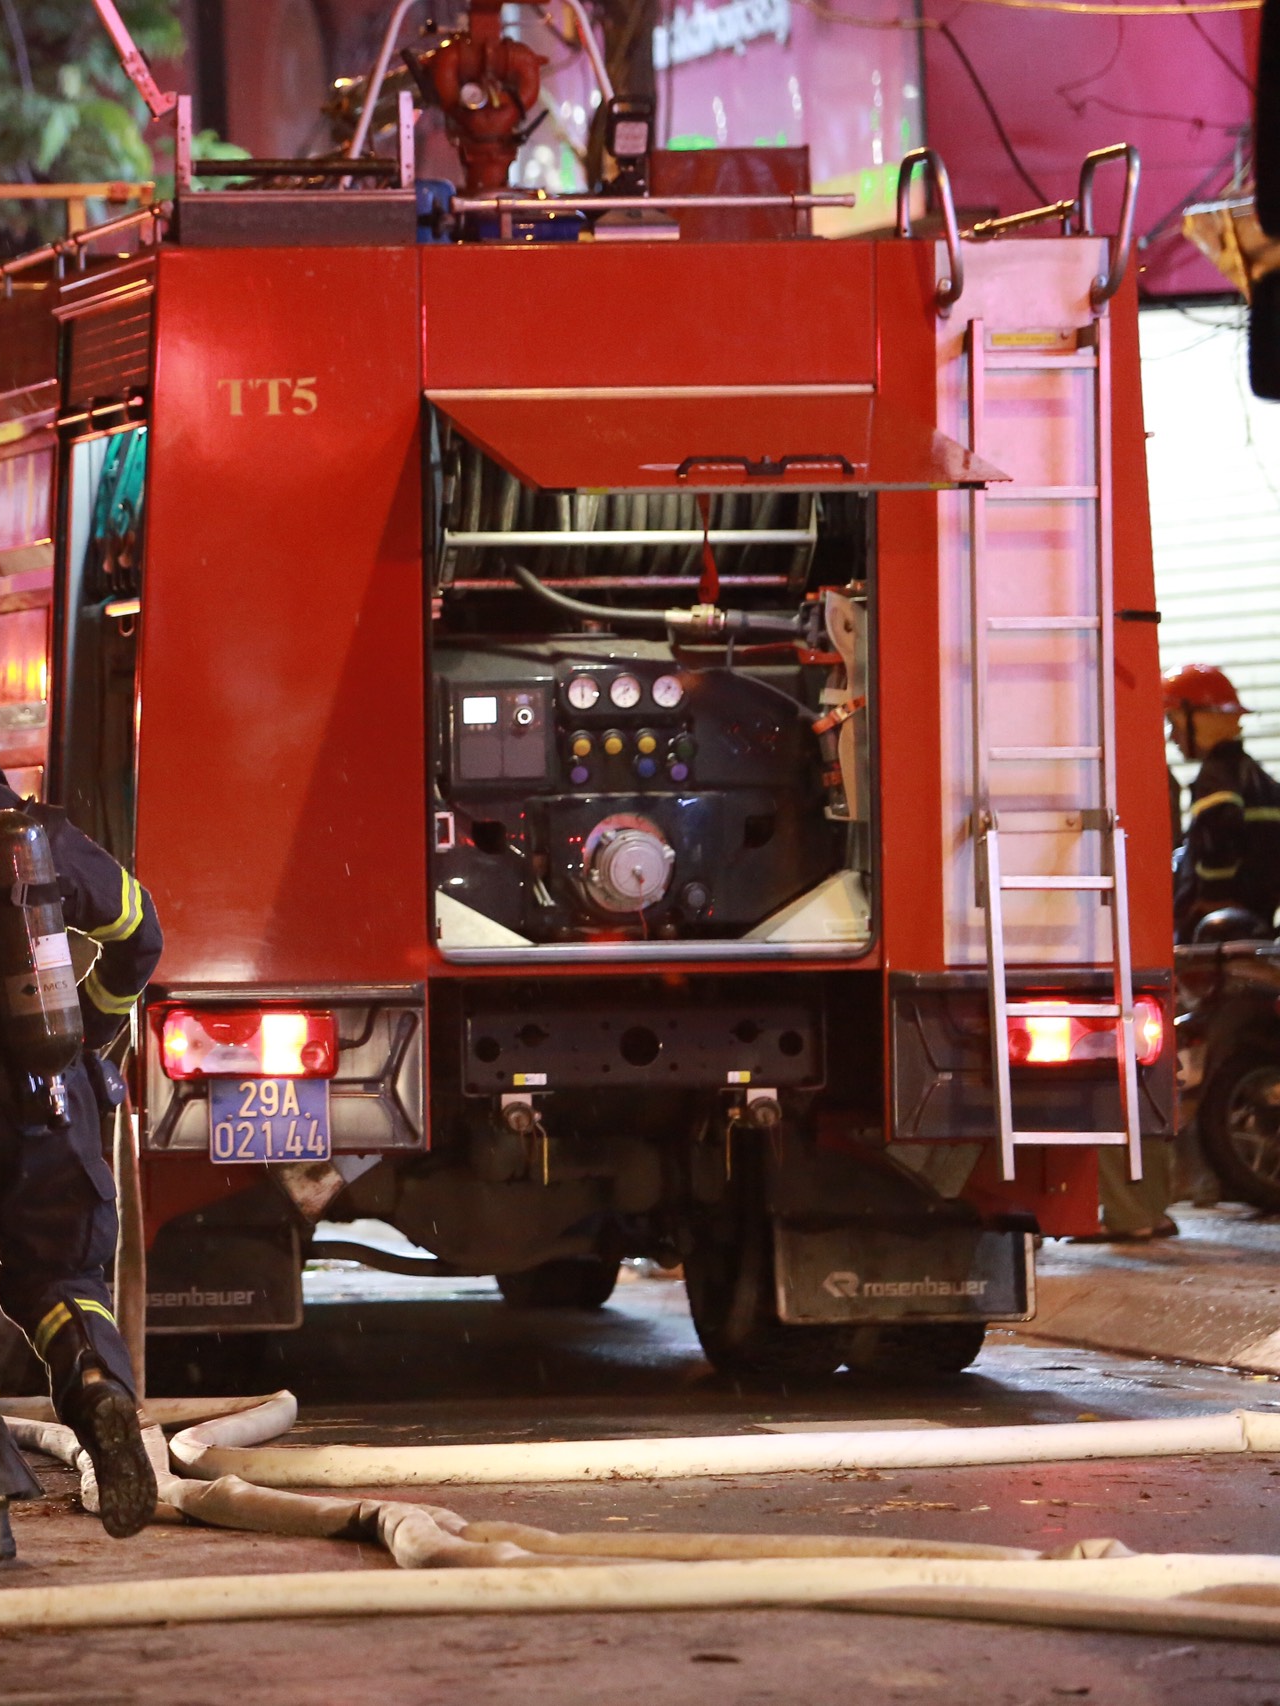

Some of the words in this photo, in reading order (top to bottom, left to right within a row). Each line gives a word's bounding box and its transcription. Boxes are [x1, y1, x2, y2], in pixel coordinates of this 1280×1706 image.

[217, 376, 319, 416] TT5
[239, 1080, 300, 1118] 29A
[214, 1120, 325, 1158] 021.44
[146, 1285, 255, 1307] senbauer
[863, 1276, 988, 1298] rosenbauer
